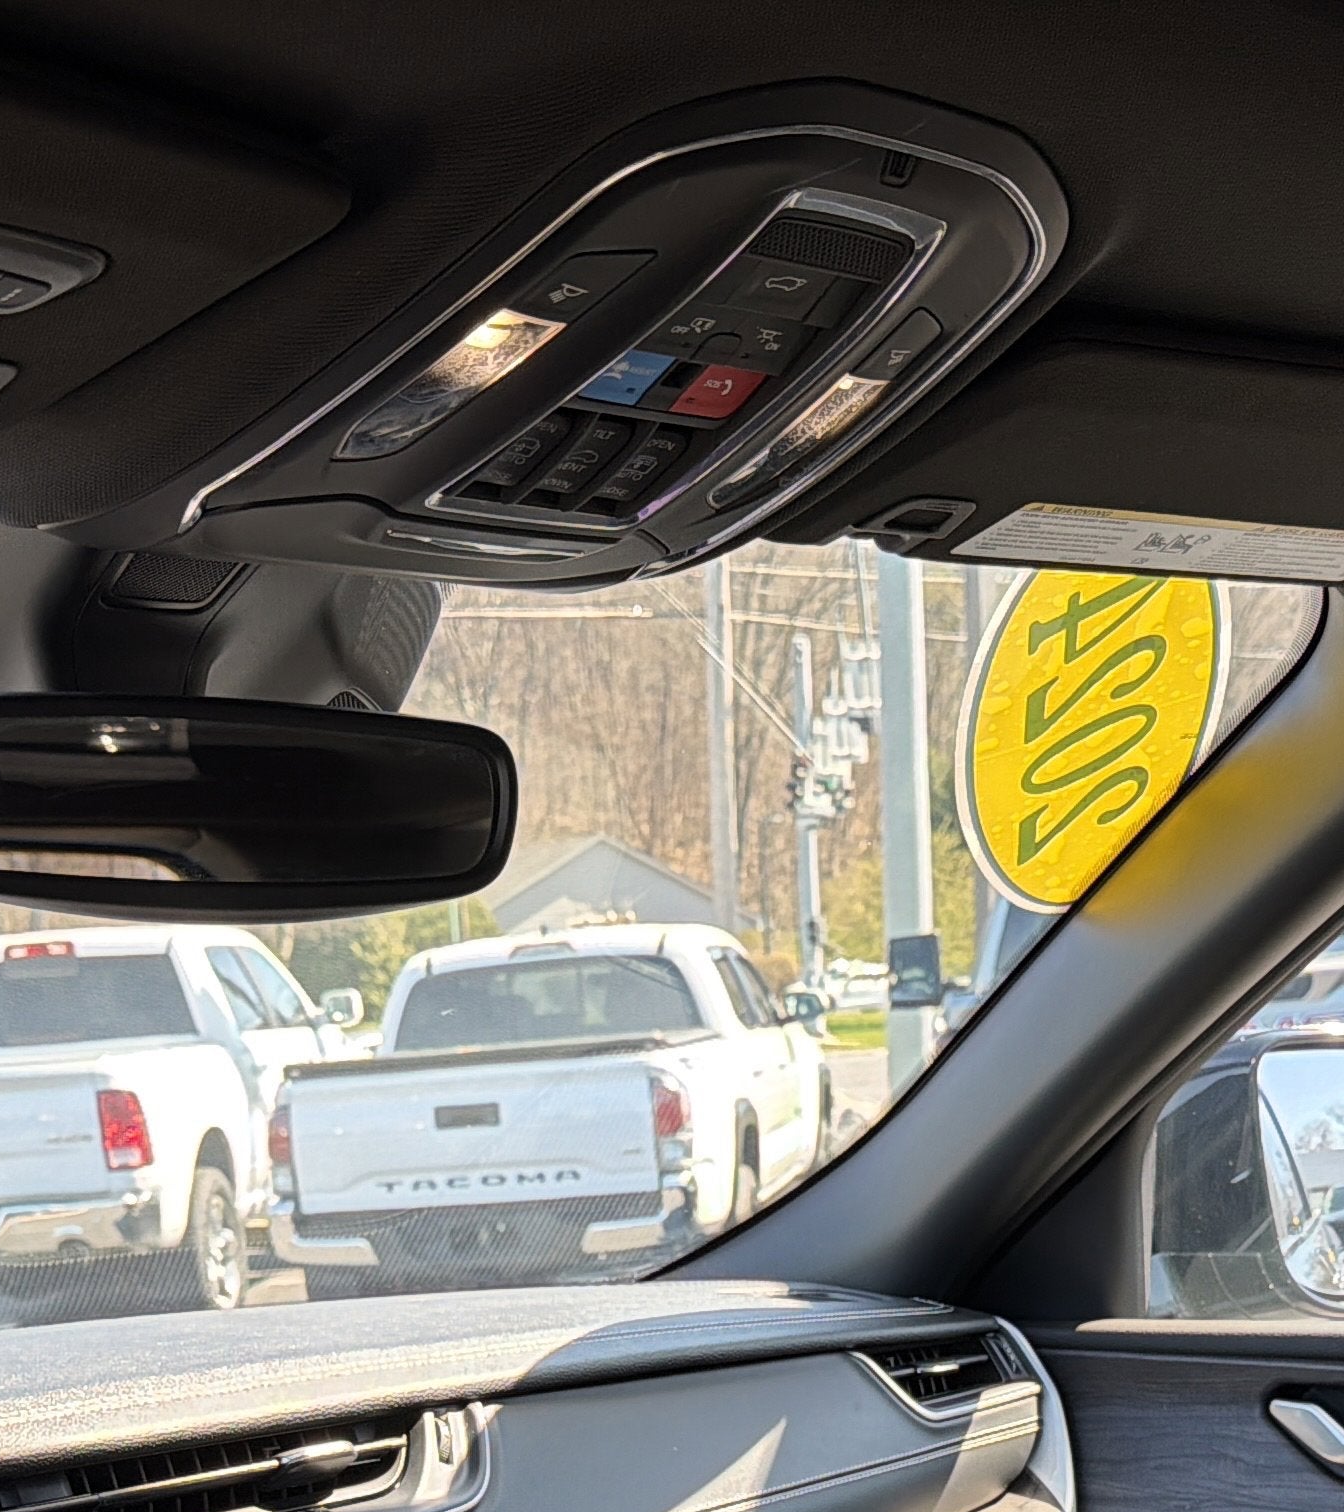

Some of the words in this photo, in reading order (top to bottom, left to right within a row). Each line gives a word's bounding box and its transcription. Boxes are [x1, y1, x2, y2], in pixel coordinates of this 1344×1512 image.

[670, 325, 690, 334] OFF
[765, 341, 781, 351] ON
[537, 421, 559, 434] PEN
[592, 428, 618, 440] TILT
[646, 438, 677, 451] OPEN
[500, 454, 527, 465] UTO
[375, 1169, 582, 1194] TACOMA
